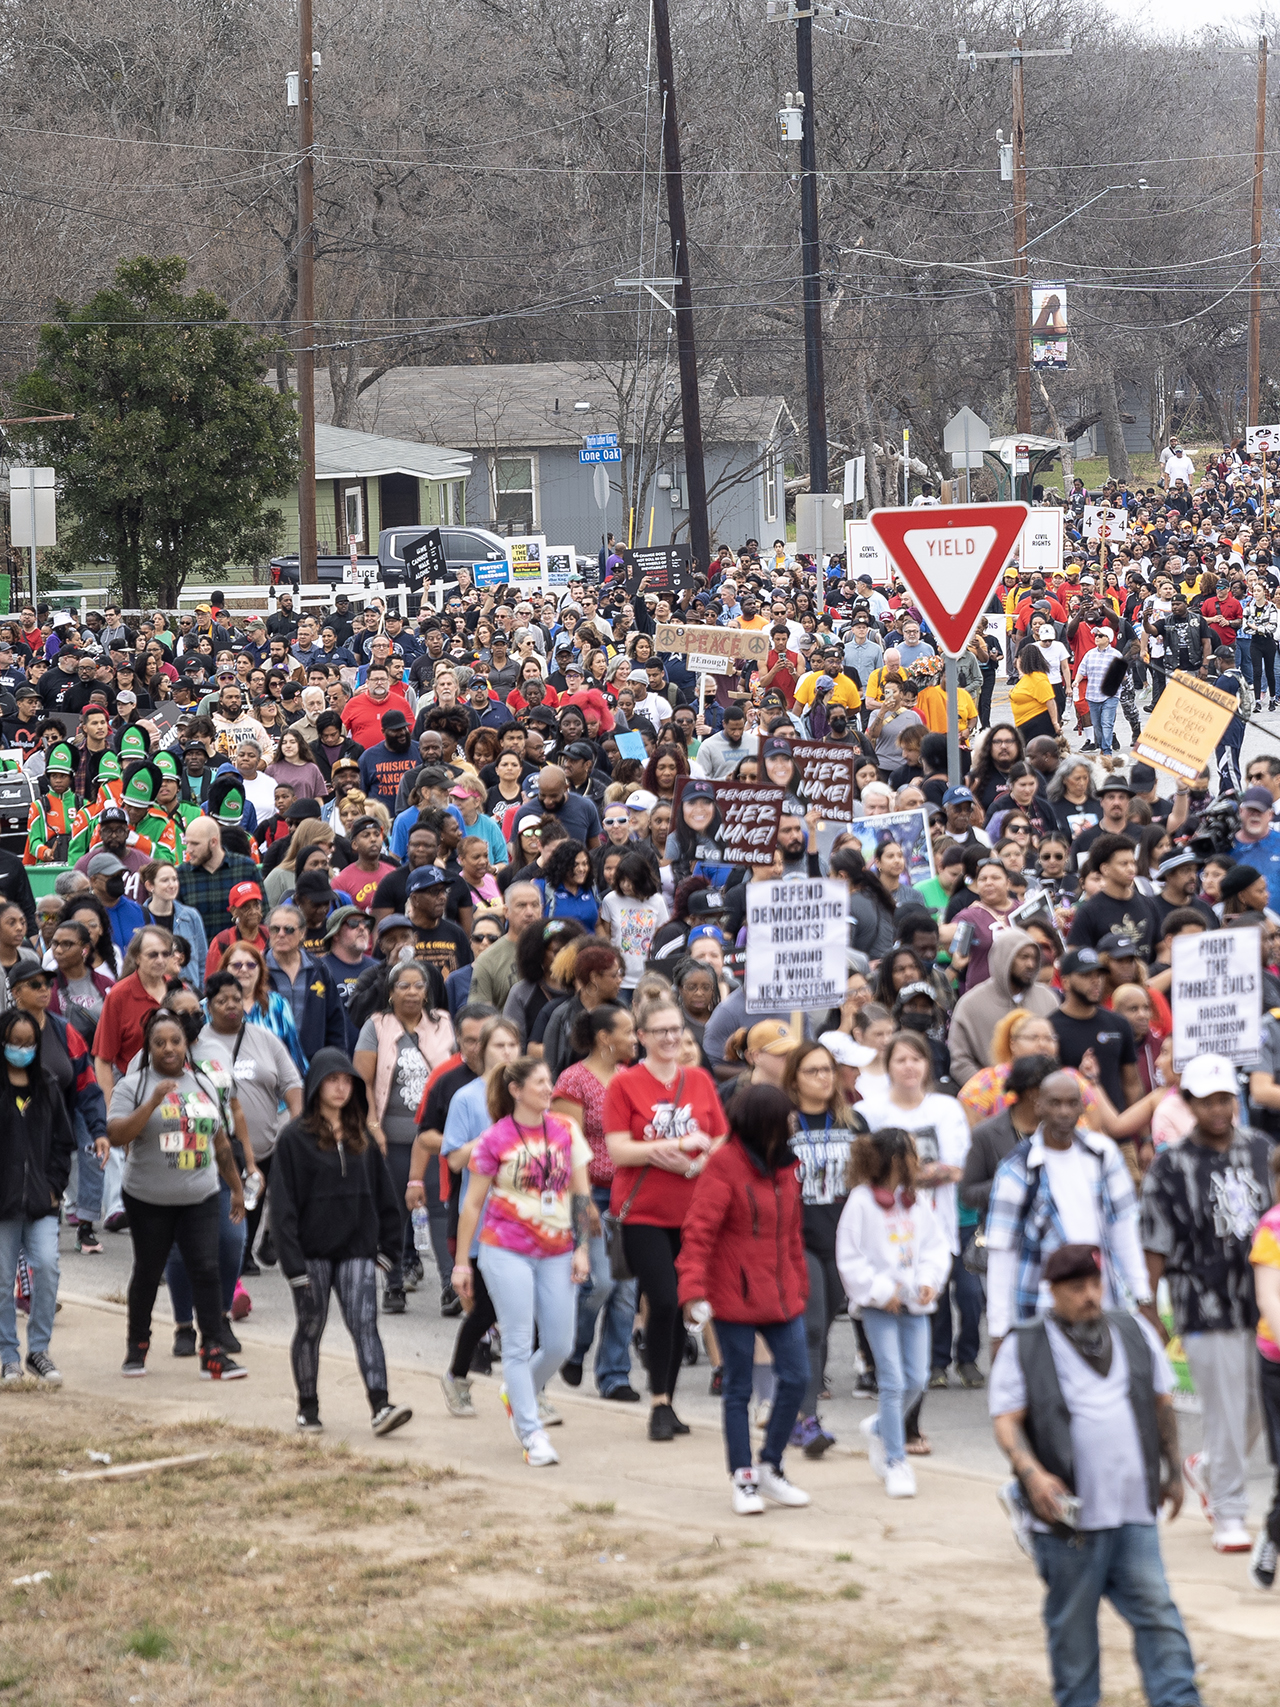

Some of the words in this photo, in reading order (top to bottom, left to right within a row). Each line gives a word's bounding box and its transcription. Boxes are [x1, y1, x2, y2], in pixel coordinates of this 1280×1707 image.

[1249, 436, 1254, 445] 5
[1274, 433, 1279, 443] 5
[581, 451, 600, 461] Lone
[603, 449, 619, 460] Oak
[1085, 516, 1092, 527] 4
[1118, 520, 1125, 531] 4
[926, 538, 975, 557] YIELD
[347, 570, 375, 578] PLICE
[685, 633, 741, 656] PEACE
[691, 656, 727, 667] #Enough
[1174, 674, 1236, 708] REMEMBER
[1174, 696, 1213, 724] Uziyah
[1169, 708, 1206, 734] Sergio
[1163, 720, 1200, 746] Garcia
[793, 746, 854, 760] REMEMBER
[375, 760, 417, 772] WHISKEY
[804, 761, 850, 782] HER
[1164, 756, 1198, 780] STRONG
[376, 773, 403, 784] TANG
[378, 785, 399, 795] FOXT
[715, 788, 784, 801] REMEMBER
[797, 780, 851, 804] NAME!
[725, 803, 777, 824] HER
[782, 800, 805, 815] Eva
[714, 823, 776, 846] NAME!
[694, 844, 721, 860] Eva
[723, 847, 773, 864] Mireles
[772, 884, 823, 902] DEFEND
[752, 902, 842, 924] DEMOCRATIC
[771, 923, 824, 943] RIGHTS!
[1199, 937, 1235, 956] FIGHT
[775, 950, 823, 965] DEMAND
[773, 968, 780, 980] A
[786, 966, 823, 981] WHOLE
[1206, 959, 1228, 976] THE
[758, 984, 783, 999] NEW
[788, 980, 835, 996] SYSTEM!
[1177, 980, 1217, 999] THREE
[1221, 975, 1255, 996] EVILS
[1198, 1004, 1237, 1020] RACISM
[1185, 1020, 1246, 1039] MILITARISM
[1197, 1038, 1238, 1054] POVERTY
